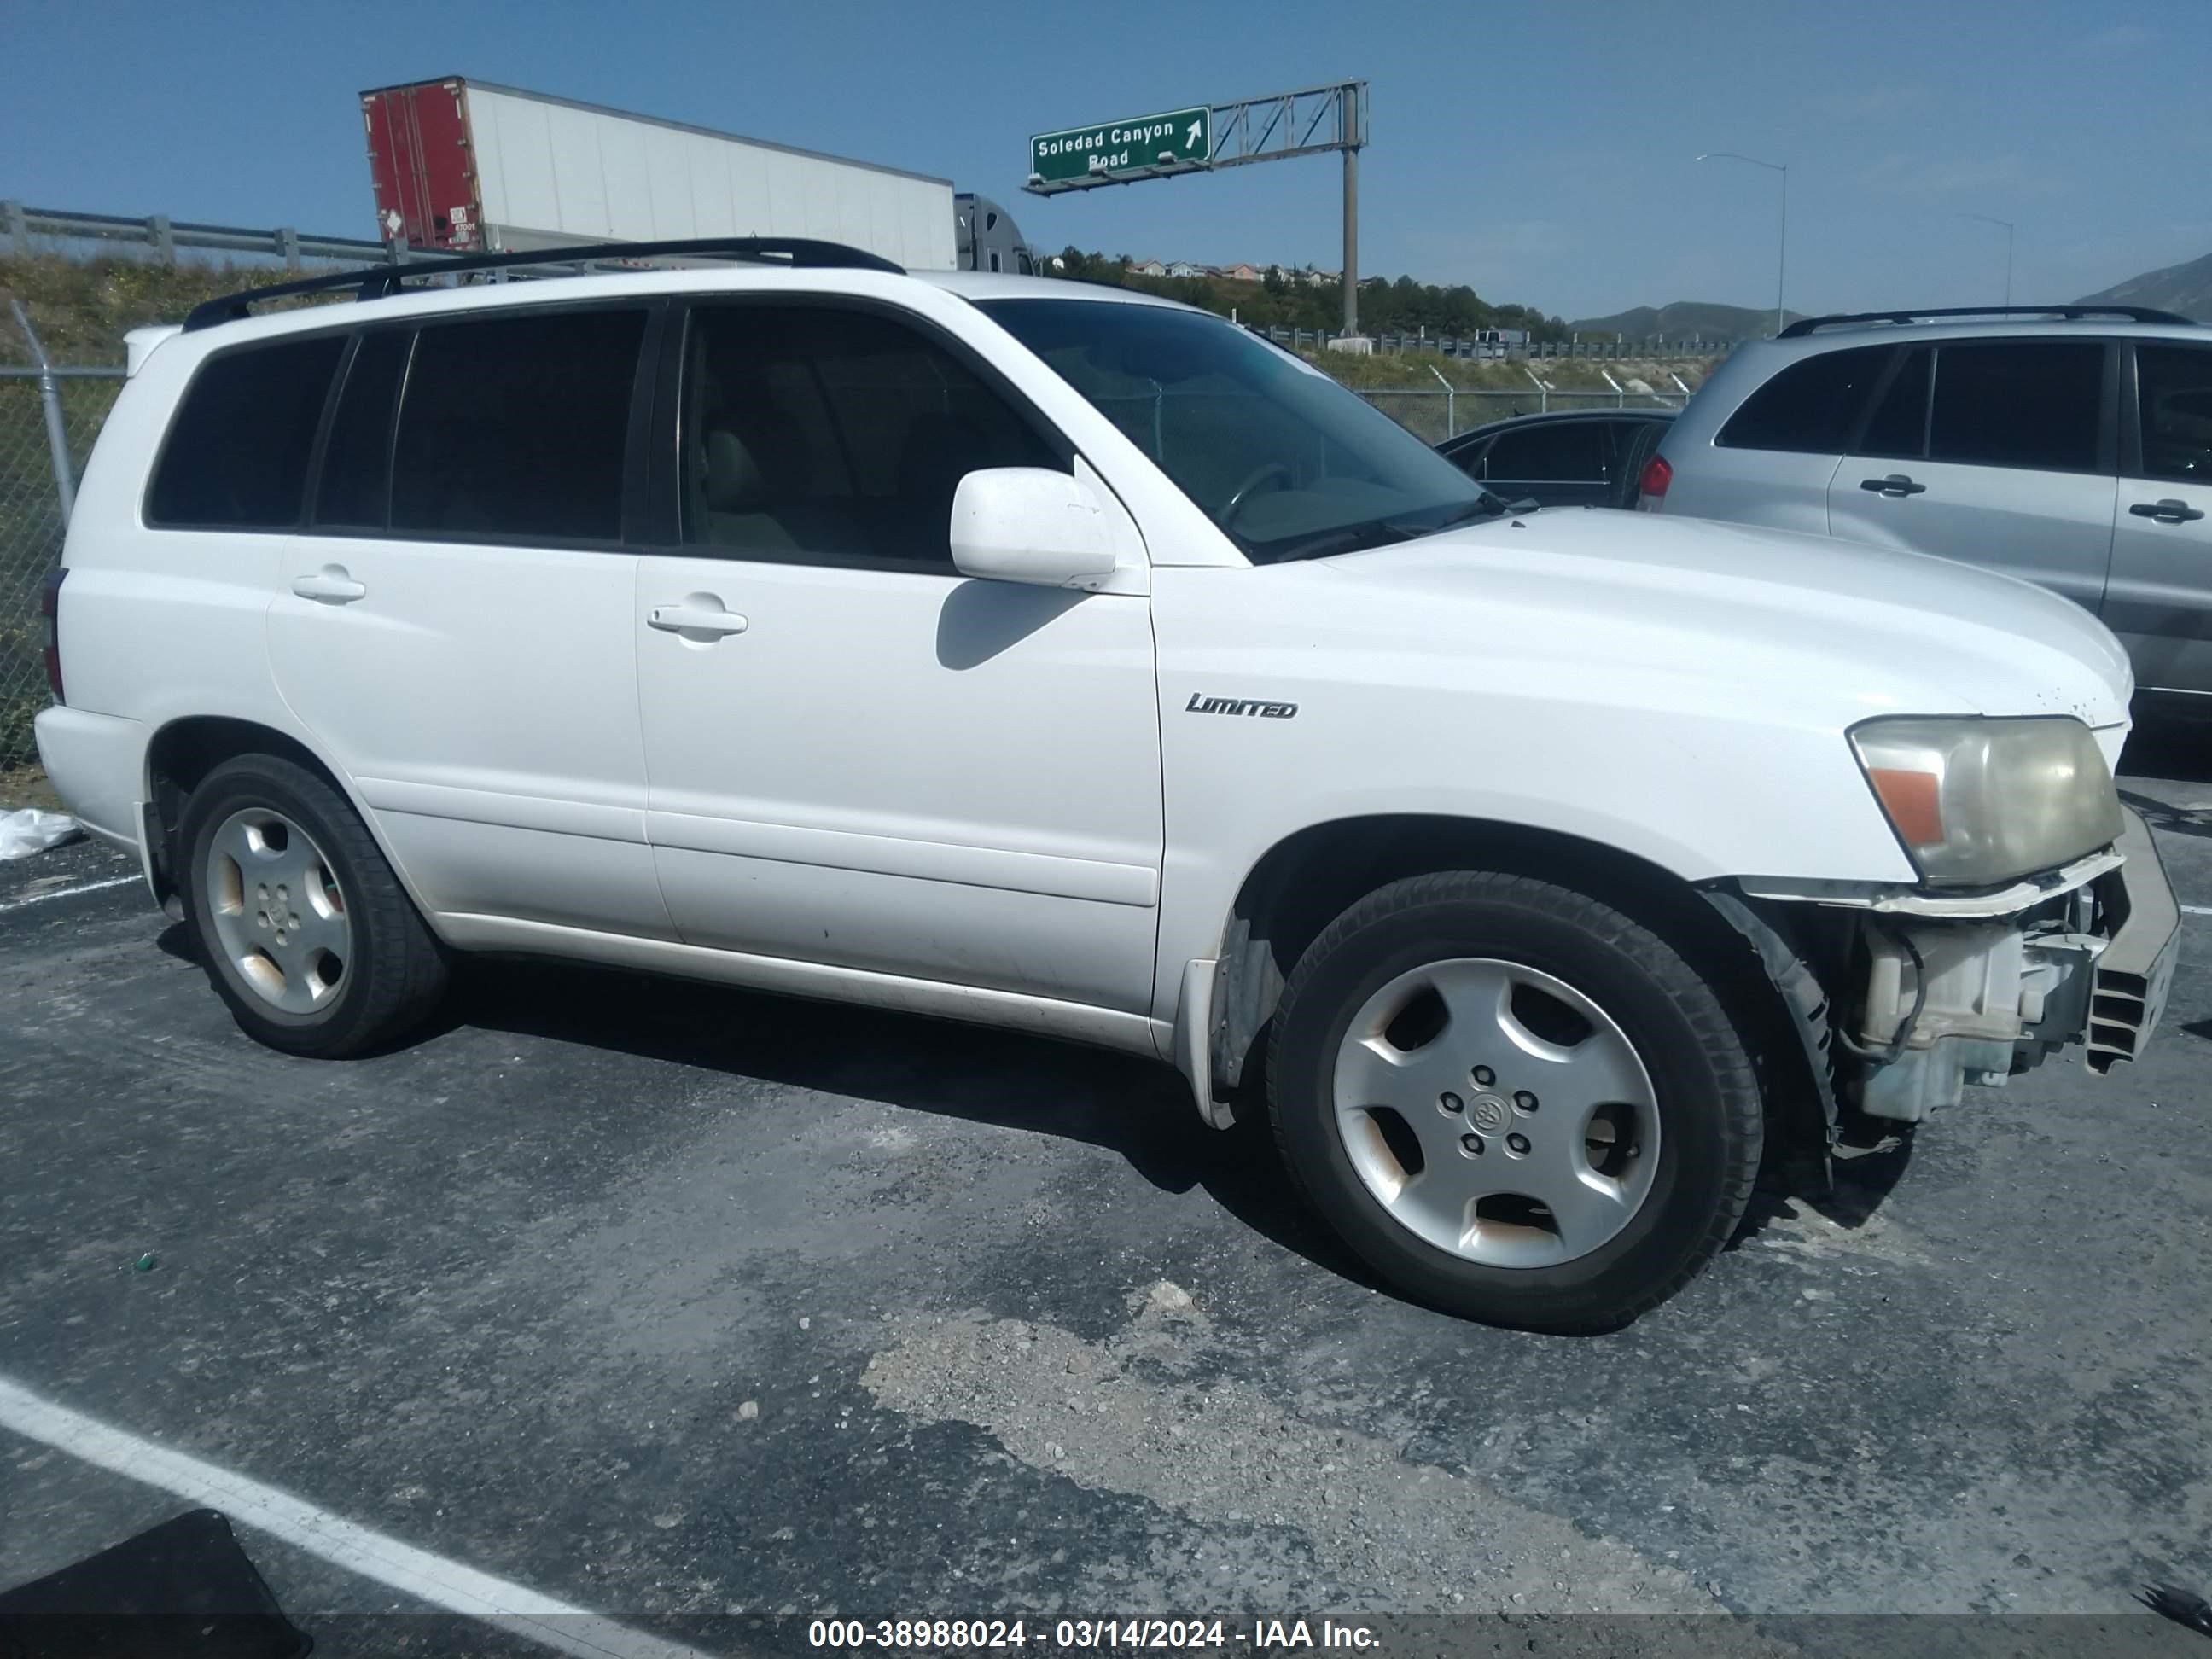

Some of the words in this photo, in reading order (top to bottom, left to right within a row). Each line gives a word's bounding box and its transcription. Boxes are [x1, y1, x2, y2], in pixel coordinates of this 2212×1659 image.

[1039, 132, 1103, 156] Soledad
[1111, 122, 1173, 145] Canyon
[1088, 149, 1129, 169] Road
